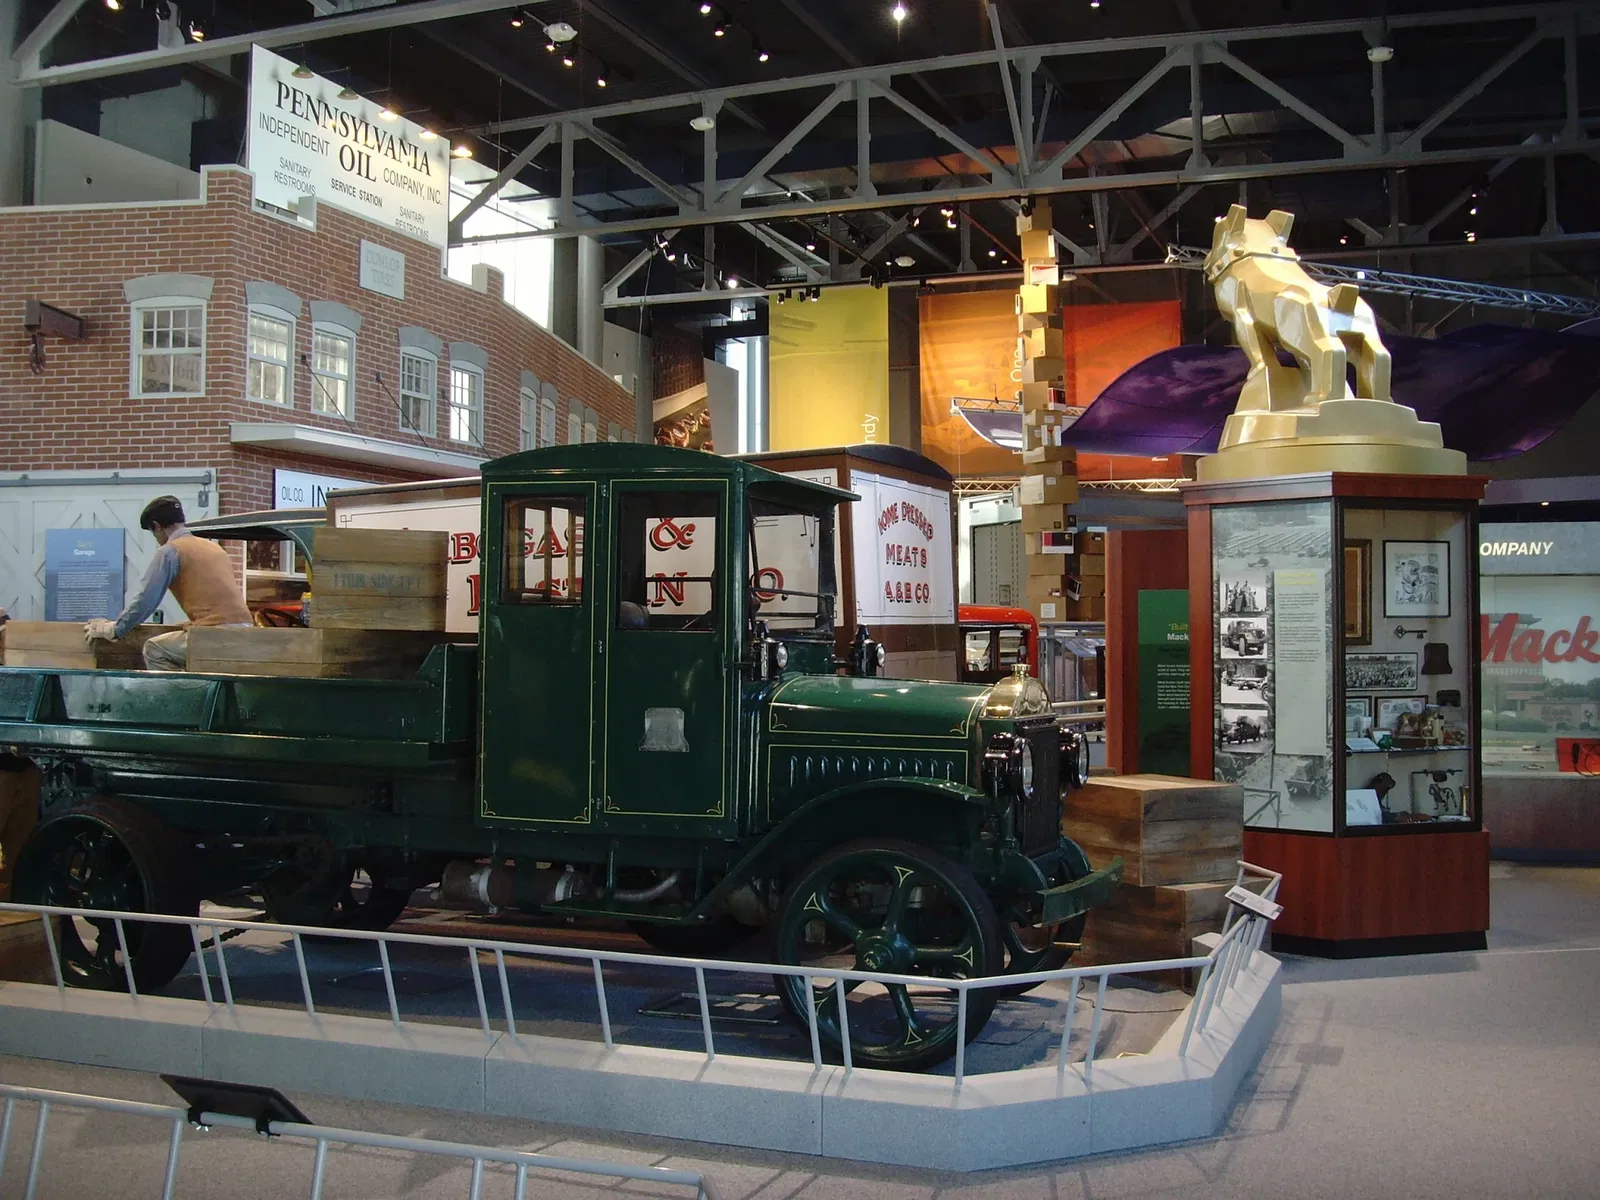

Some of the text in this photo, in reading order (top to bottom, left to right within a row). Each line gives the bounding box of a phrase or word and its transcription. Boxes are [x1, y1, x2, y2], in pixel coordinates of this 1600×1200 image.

[259, 111, 330, 156] INDEPENDENT
[275, 81, 431, 176] PENNSYLVANIA
[279, 157, 312, 179] SANITARY
[339, 144, 376, 182] OIL
[274, 171, 316, 196] RESTROOMS
[331, 178, 383, 208] SERVICE STATION
[383, 167, 442, 206] COMPANY, INC.
[399, 206, 425, 225] SANITARY
[860, 412, 880, 444] ndy
[281, 486, 292, 501] OIL
[311, 484, 340, 508] IN
[650, 517, 696, 551] &
[878, 501, 934, 542] HOME DRESSED
[885, 543, 928, 568] MEATS
[1479, 541, 1553, 556] OMPANY
[1168, 633, 1189, 641] Mack
[1480, 612, 1600, 663] Mack
